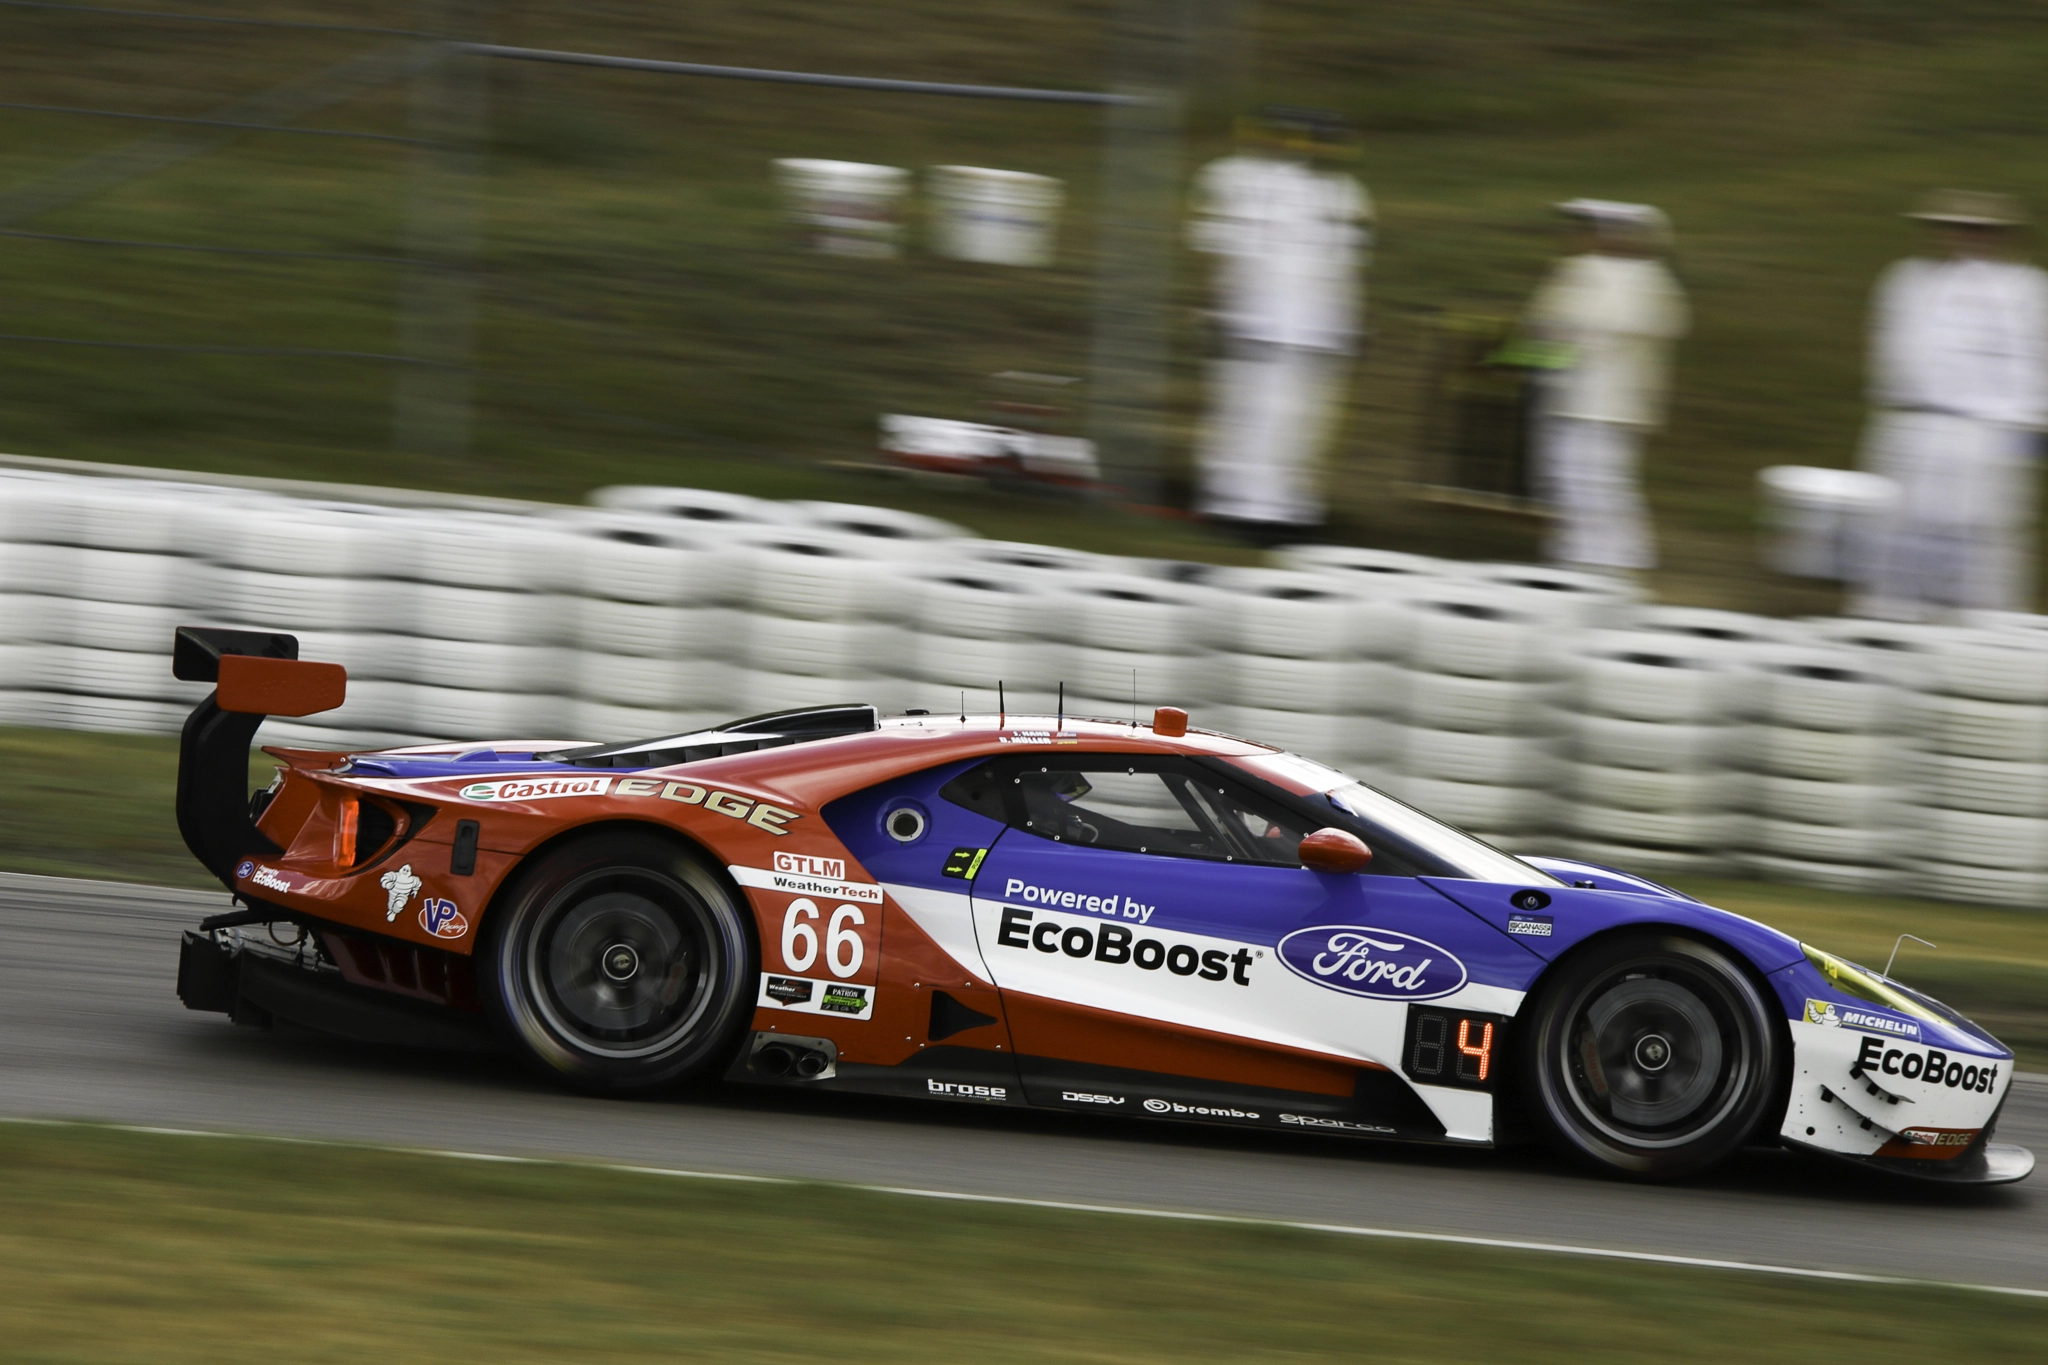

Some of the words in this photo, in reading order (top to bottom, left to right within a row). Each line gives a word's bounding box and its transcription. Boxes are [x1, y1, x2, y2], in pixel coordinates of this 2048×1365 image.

[499, 779, 600, 799] Castrol
[614, 778, 801, 836] EDGE
[776, 854, 842, 878] GTLM
[252, 870, 291, 894] EcoBoost
[774, 876, 879, 900] WeatherTech
[1005, 878, 1119, 915] Powered
[1123, 897, 1156, 925] by
[424, 898, 457, 935] VP
[781, 897, 866, 979] 66
[1312, 932, 1432, 991] Ford
[1842, 1011, 1918, 1036] MICHELIN
[1458, 1019, 1493, 1081] 4
[1857, 1036, 1999, 1095] EcoBoost
[927, 1079, 1007, 1098] brose
[1062, 1091, 1125, 1105] DSSV
[1173, 1102, 1261, 1119] brembo
[1278, 1113, 1396, 1133] sparco
[1936, 1133, 1972, 1146] EDGE
